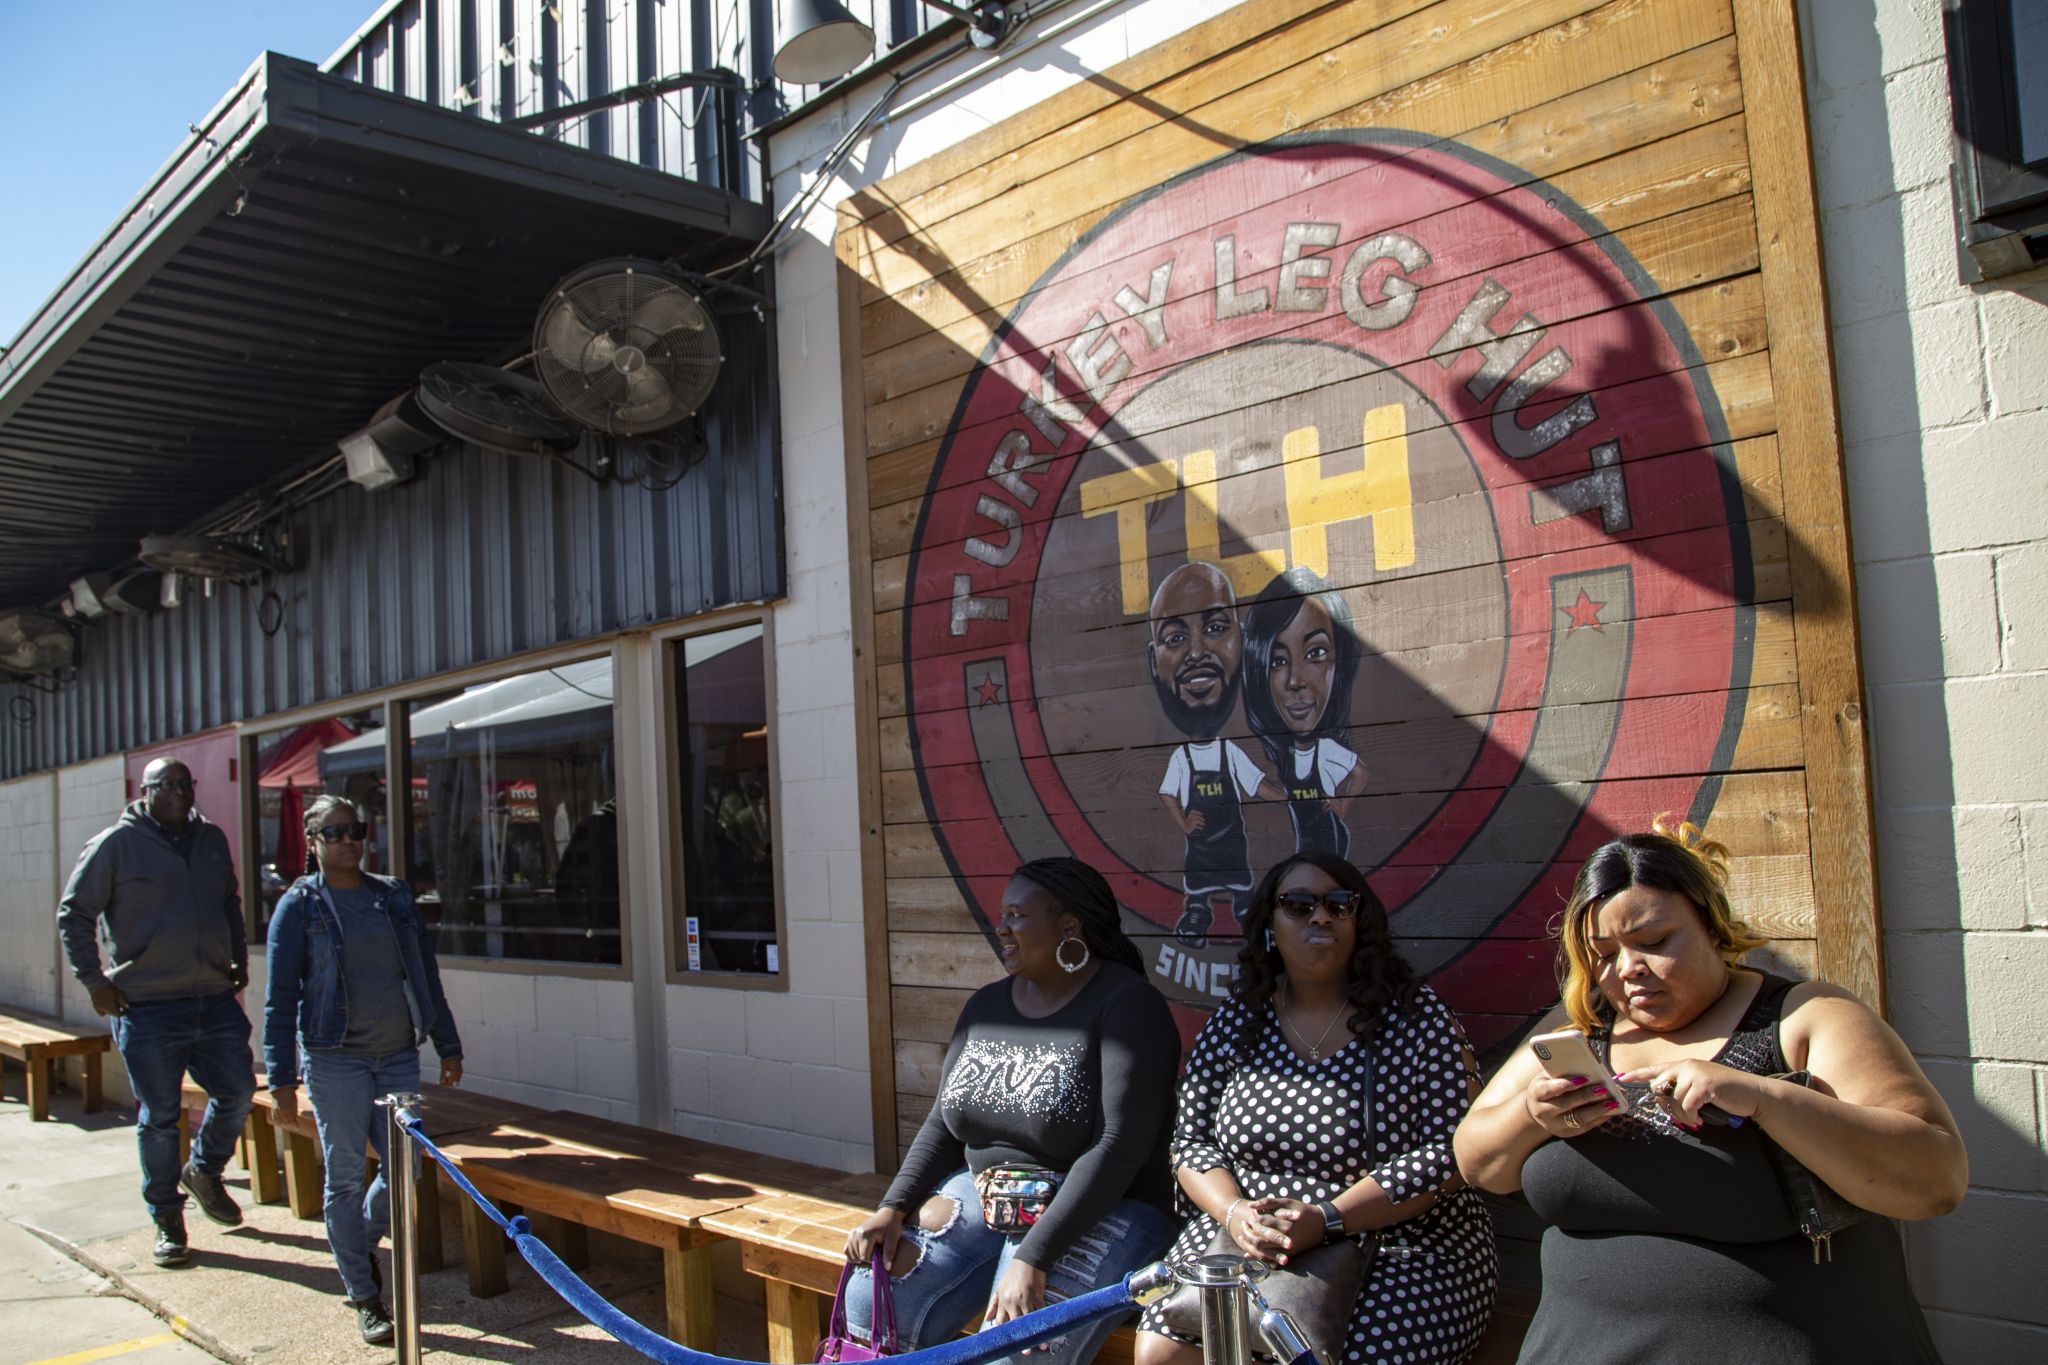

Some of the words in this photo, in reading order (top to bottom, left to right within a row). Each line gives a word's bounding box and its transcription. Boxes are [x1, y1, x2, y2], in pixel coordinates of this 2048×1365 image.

[949, 257, 1176, 638] TURKEY
[1213, 221, 1433, 332] LEG
[1427, 276, 1635, 535] HUT
[1079, 402, 1417, 616] TLH
[1197, 782, 1223, 797] TLH
[949, 1055, 1063, 1101] DIVA
